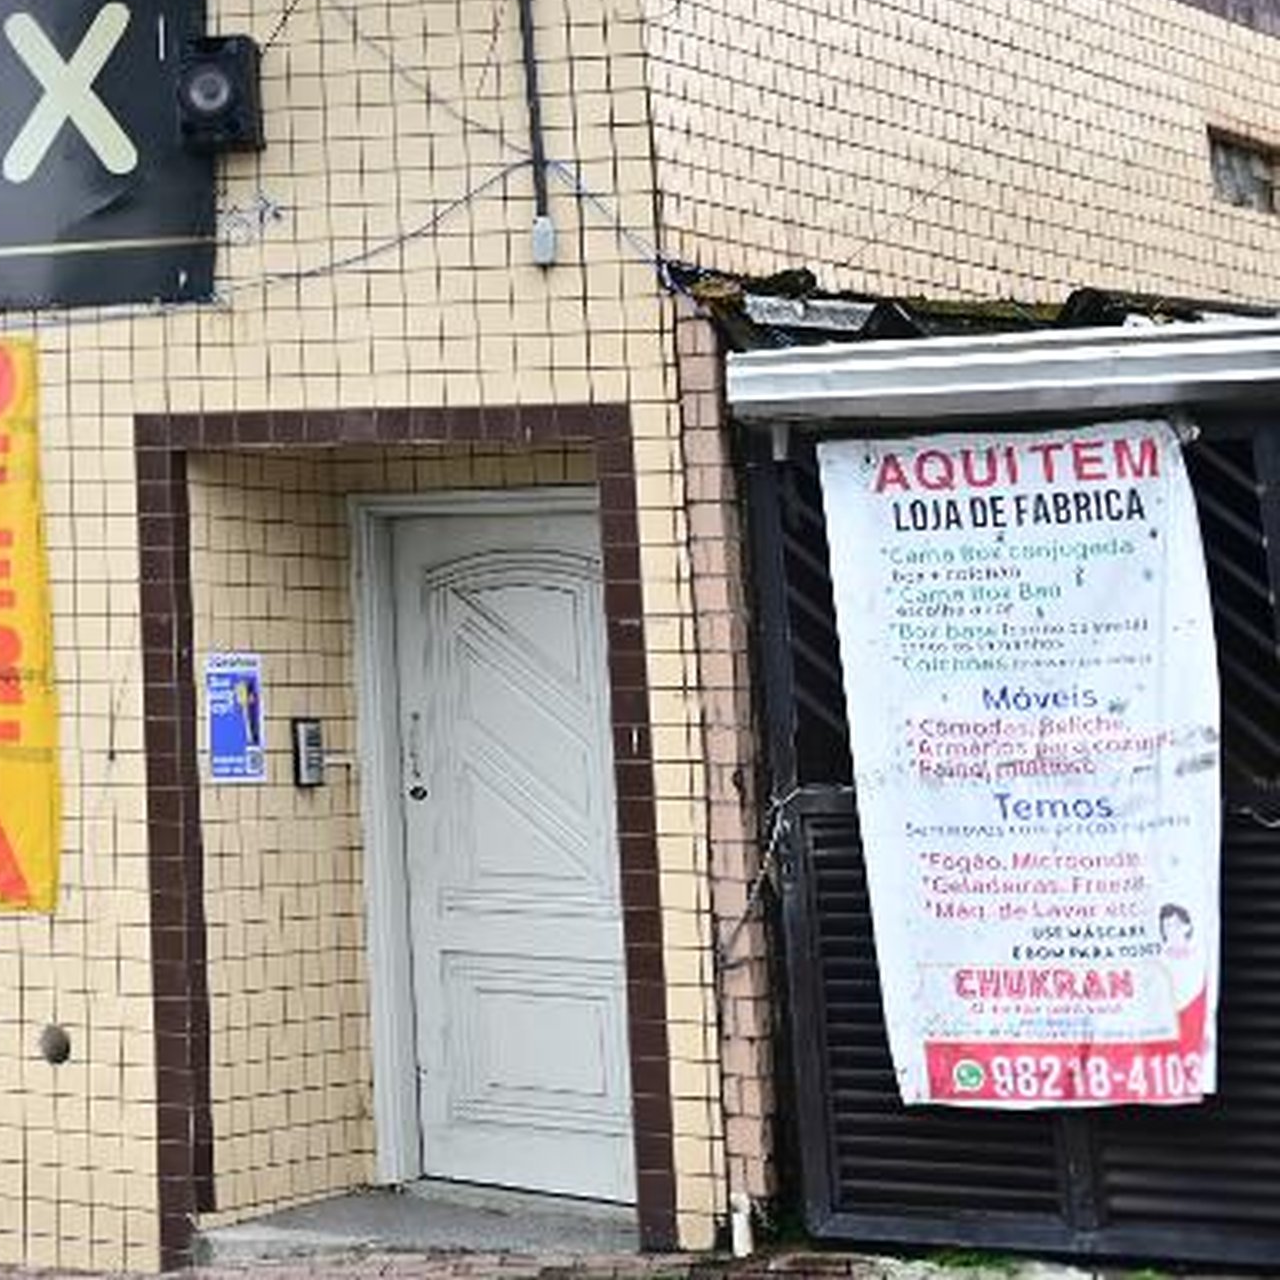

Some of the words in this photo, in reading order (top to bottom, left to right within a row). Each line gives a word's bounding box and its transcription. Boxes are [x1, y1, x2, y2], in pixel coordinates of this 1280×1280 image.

[875, 445, 1019, 494] AQUI
[1028, 437, 1161, 482] TEM
[893, 498, 964, 532] LOJA
[970, 495, 1007, 528] DE
[1015, 488, 1146, 527] FABRICA
[981, 684, 1099, 711] Móveis
[994, 792, 1115, 821] Temos
[954, 967, 1135, 999] CHUKRAN
[991, 1052, 1203, 1098] 98218-4103
